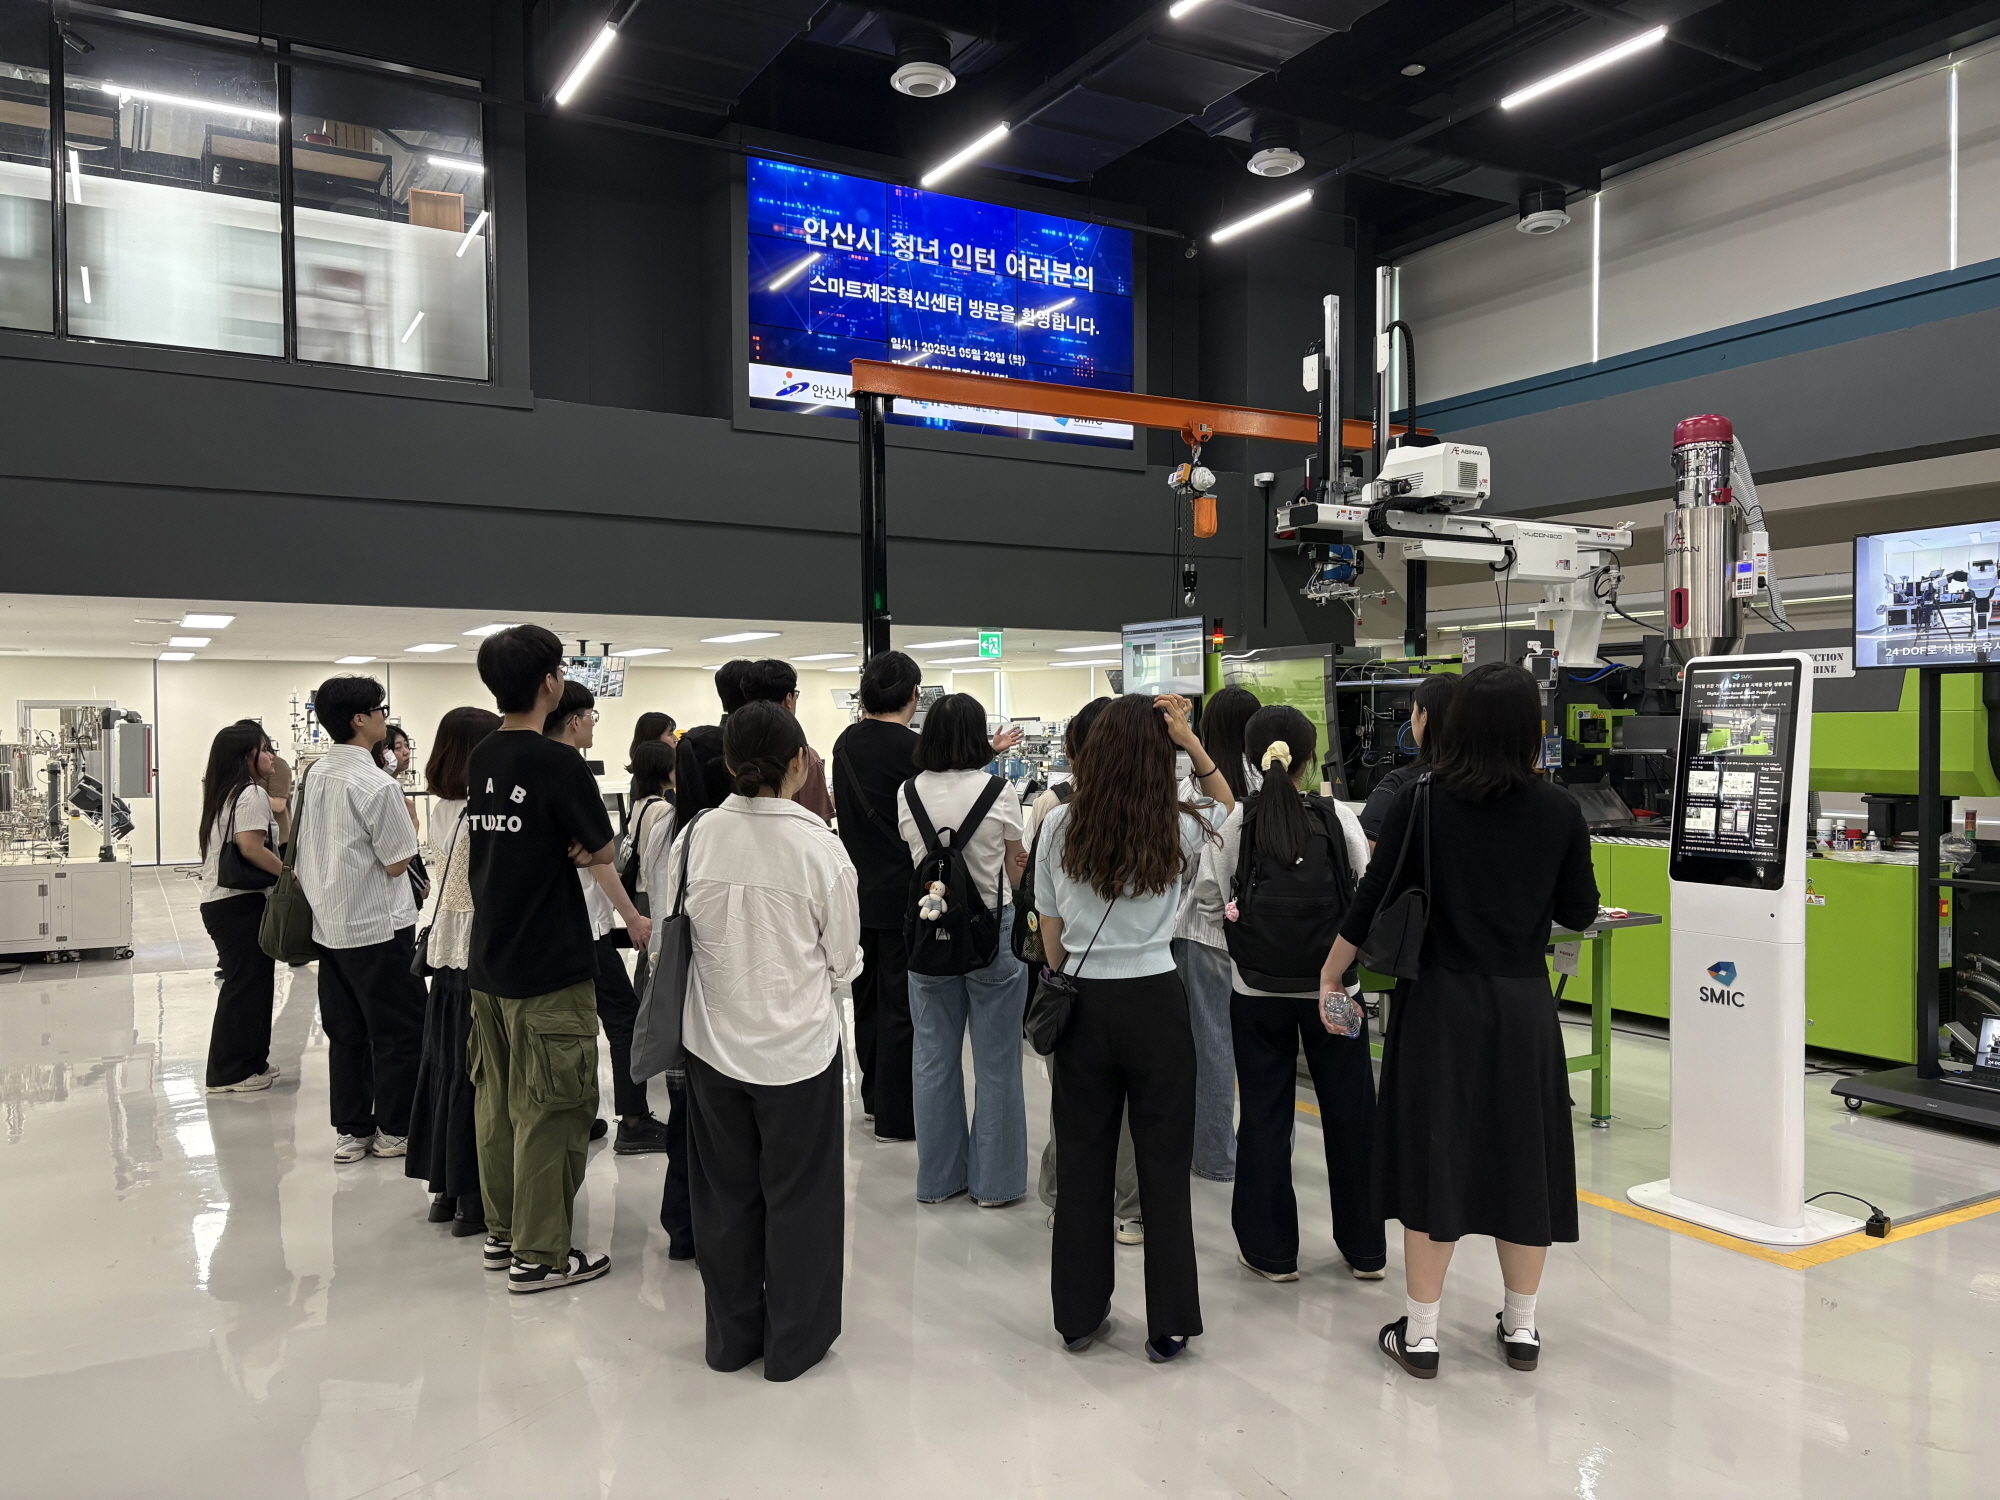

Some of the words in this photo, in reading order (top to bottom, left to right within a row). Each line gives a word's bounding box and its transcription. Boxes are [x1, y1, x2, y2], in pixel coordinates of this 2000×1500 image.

[803, 217, 881, 257] 안산시
[891, 231, 940, 265] 청년
[950, 242, 996, 275] 인턴
[1005, 253, 1094, 293] 여러분의
[808, 274, 962, 316] 스마트제조혁신센터
[968, 298, 1016, 324] 방문을
[1021, 307, 1100, 336] 환영합니다.
[890, 336, 912, 352] 일시
[921, 341, 957, 358] 2025년
[959, 346, 981, 361] 05월
[983, 350, 1006, 365] 29일
[812, 383, 848, 402] 안산시
[1885, 647, 1900, 658] 24
[1902, 644, 1938, 658] DOF로
[1941, 642, 1978, 655] 사람과
[466, 814, 522, 833] TUDIO
[1699, 985, 1745, 1008] SMIC
